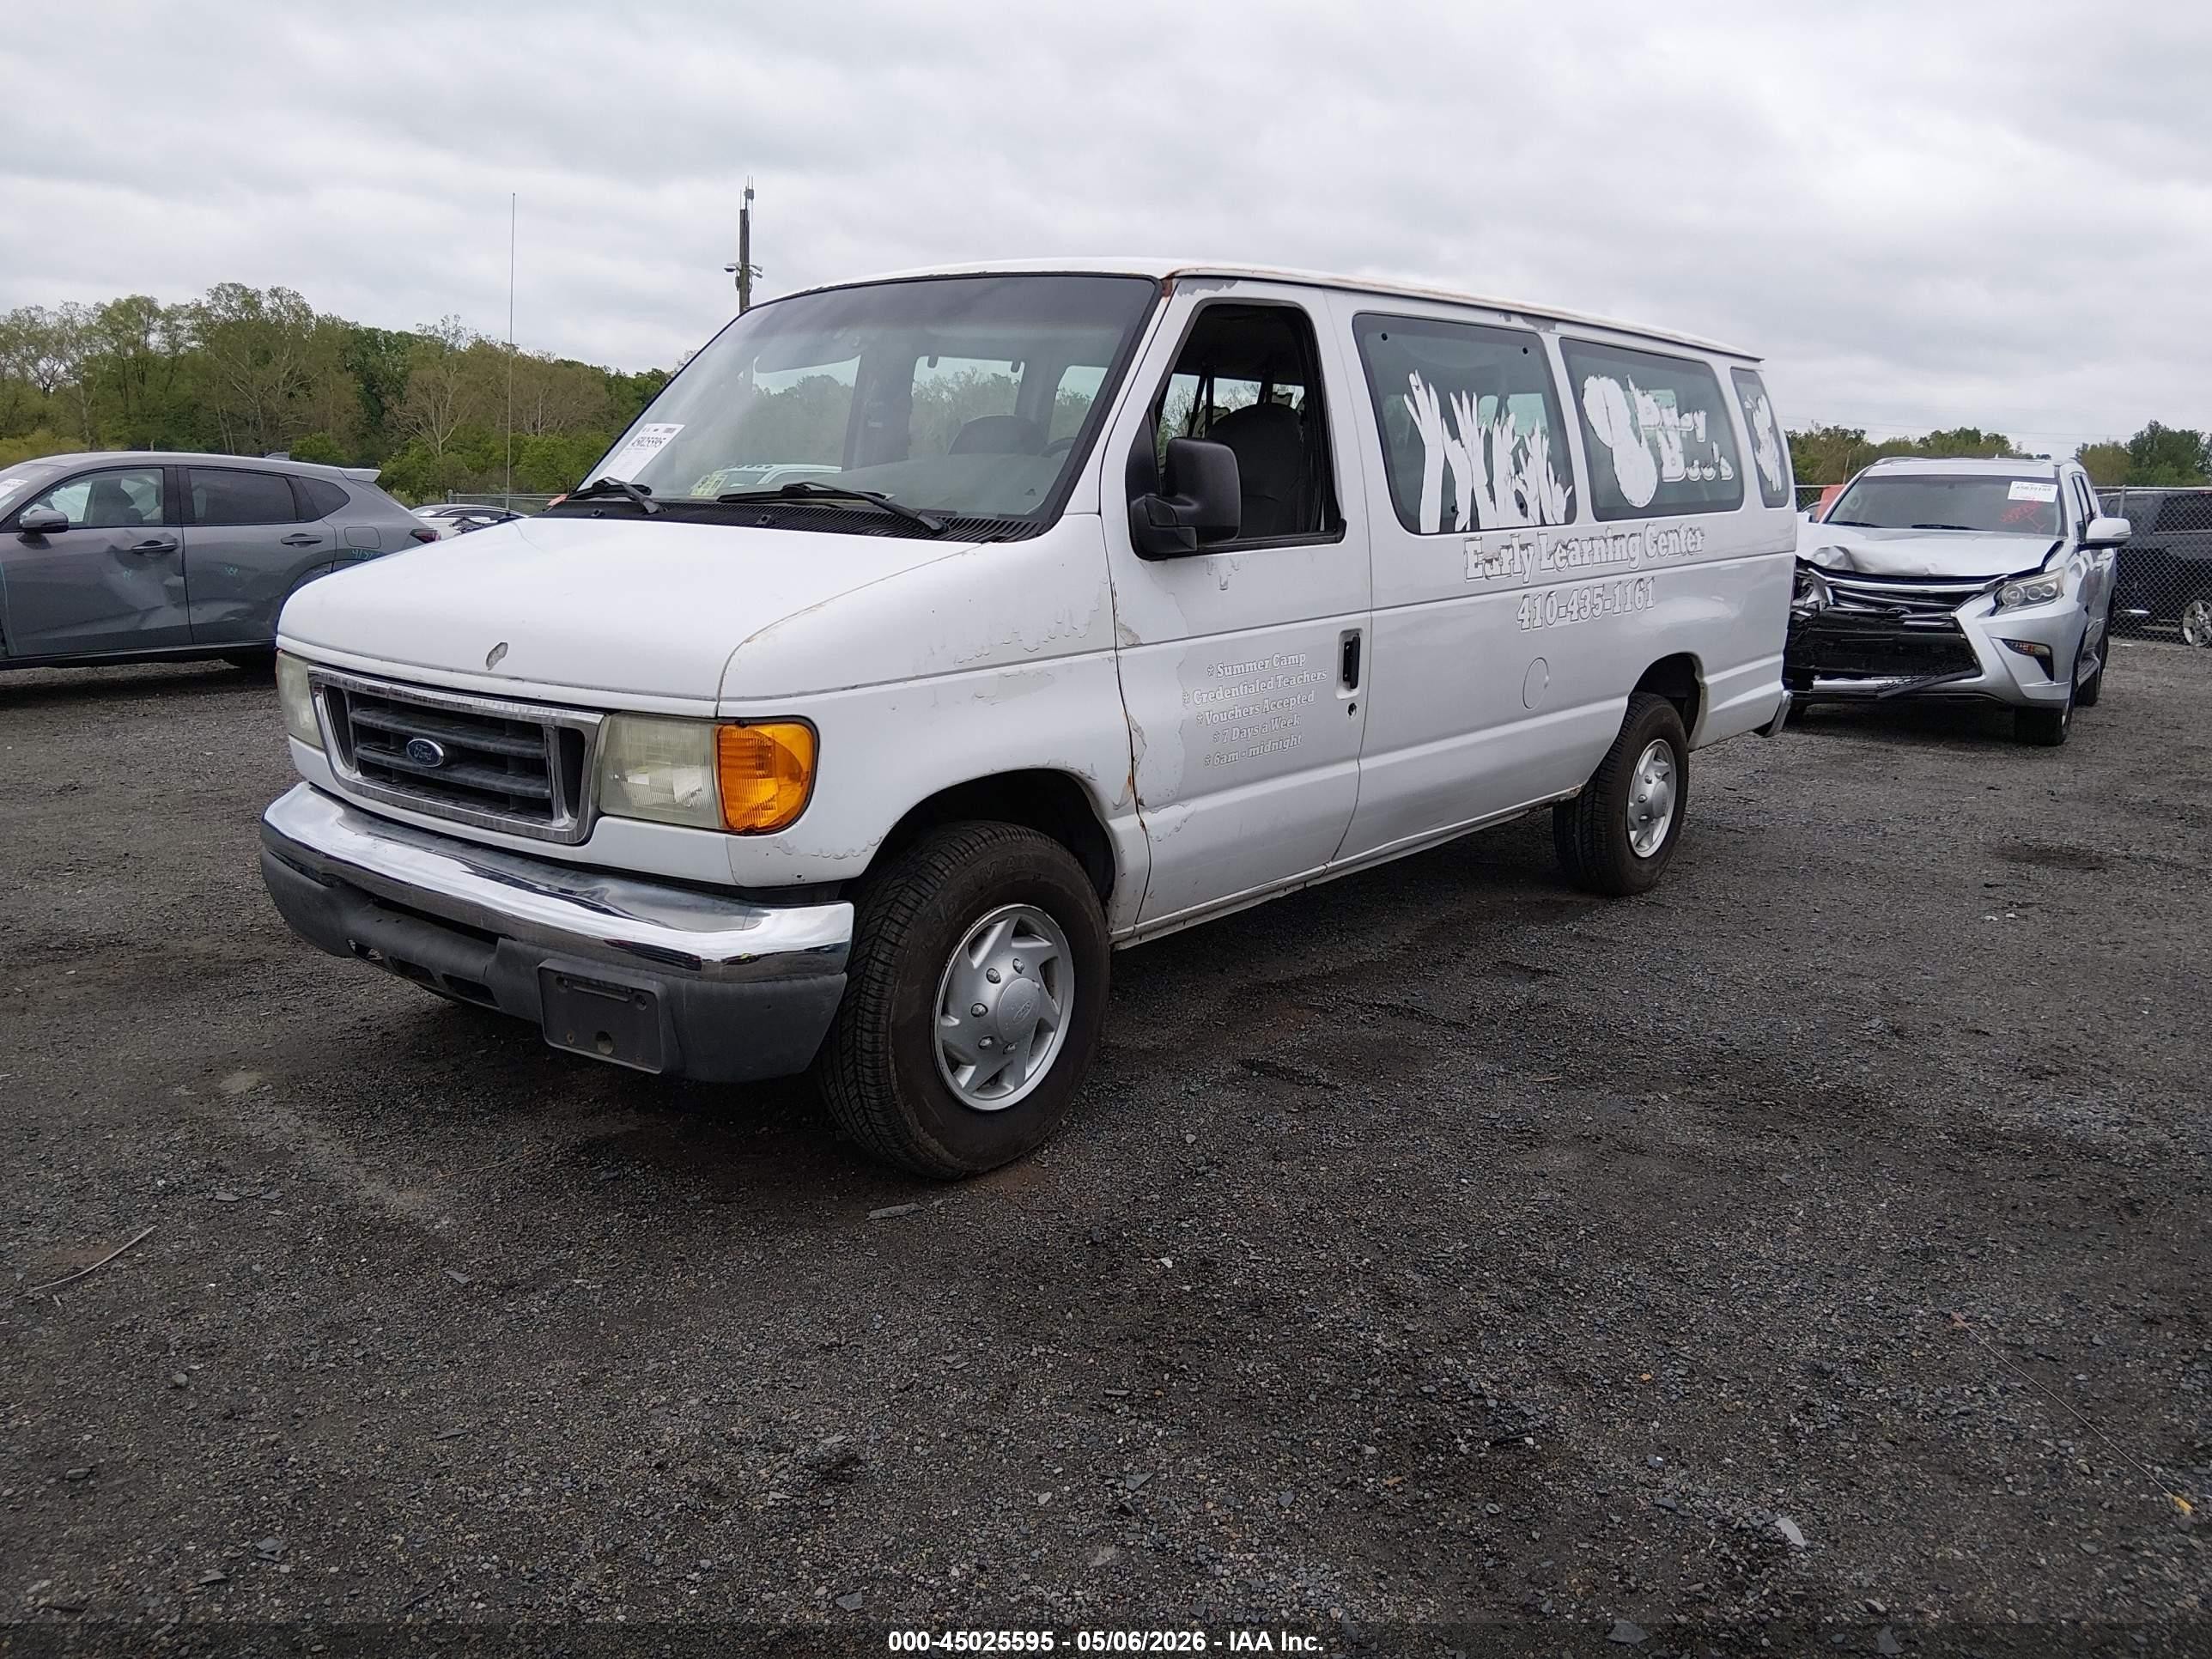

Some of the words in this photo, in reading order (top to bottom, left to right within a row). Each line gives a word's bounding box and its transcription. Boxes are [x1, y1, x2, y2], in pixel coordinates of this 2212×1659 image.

[1463, 534, 1535, 584] Early
[1537, 527, 1642, 572] Learning
[1644, 522, 1705, 559] Center
[1516, 577, 1656, 631] 410-435-1161
[1216, 658, 1271, 678] Summer
[1272, 652, 1307, 670] Camp
[1192, 677, 1274, 705] Credentialed
[1276, 669, 1328, 689] Teachers
[1204, 704, 1261, 726] Vouchers
[1262, 690, 1316, 713] Accepted
[1222, 730, 1230, 744] 7
[1231, 724, 1260, 743] Days
[1261, 723, 1269, 734] a
[1270, 713, 1302, 732] Week
[1213, 750, 1240, 766] 6am
[1248, 732, 1304, 758] midnight
